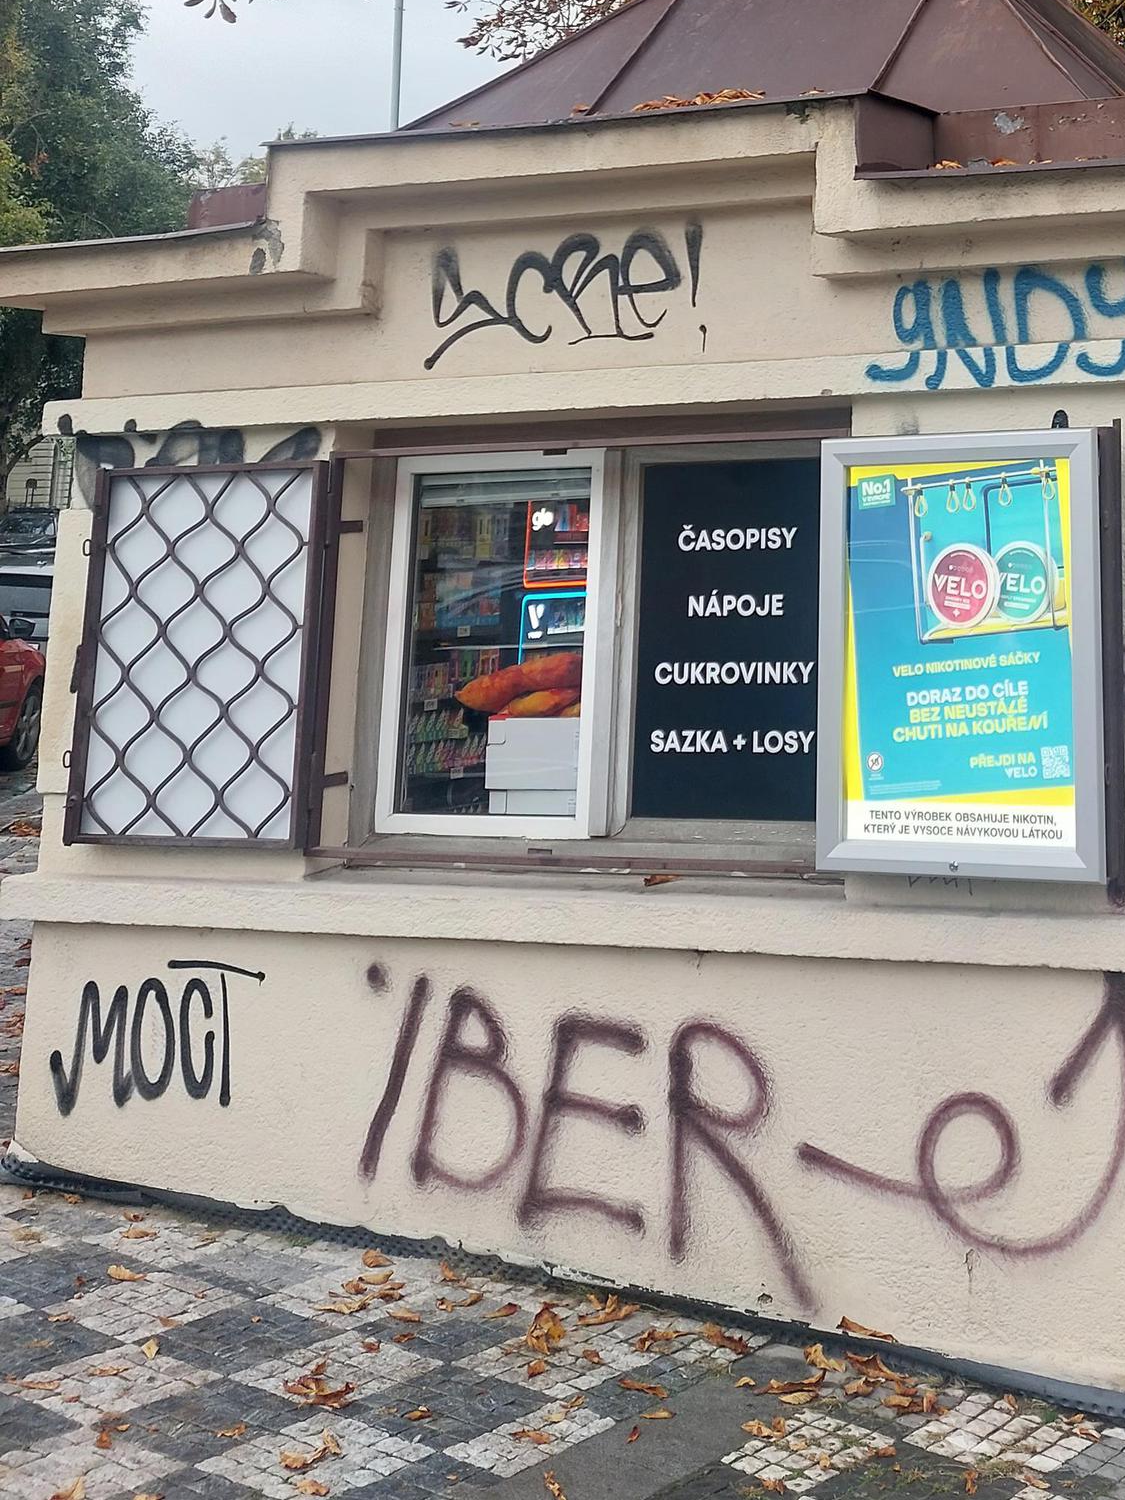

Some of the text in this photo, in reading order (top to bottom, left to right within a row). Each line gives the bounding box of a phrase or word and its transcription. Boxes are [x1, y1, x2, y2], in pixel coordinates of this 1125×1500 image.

[861, 479, 891, 496] No.1
[678, 524, 797, 551] ČASOPISY
[933, 573, 987, 599] VELO
[999, 573, 1046, 595] VELO
[687, 589, 784, 617] NÁPOJE
[654, 661, 815, 685] CUKROVINKY
[893, 651, 1041, 678] VELO NIKOTINOVÉ SÁČKY
[906, 679, 1029, 707] DORAZ DO CÍLE
[909, 697, 1028, 724] BEZ NEUSTÁLÉ
[892, 711, 1049, 743] CHUTI NA KOUŘENÍ
[650, 729, 815, 754] SAZKA + LOSY
[969, 752, 1036, 769] PŘEJDI NA
[1005, 766, 1038, 779] VELO
[869, 808, 1057, 827] TENTO VÝROBEK OBSAHUJE NIKOTIN,
[863, 821, 1063, 840] KTERÝ JE VYSOCE NÁVYKOVOU LÁTKOU
